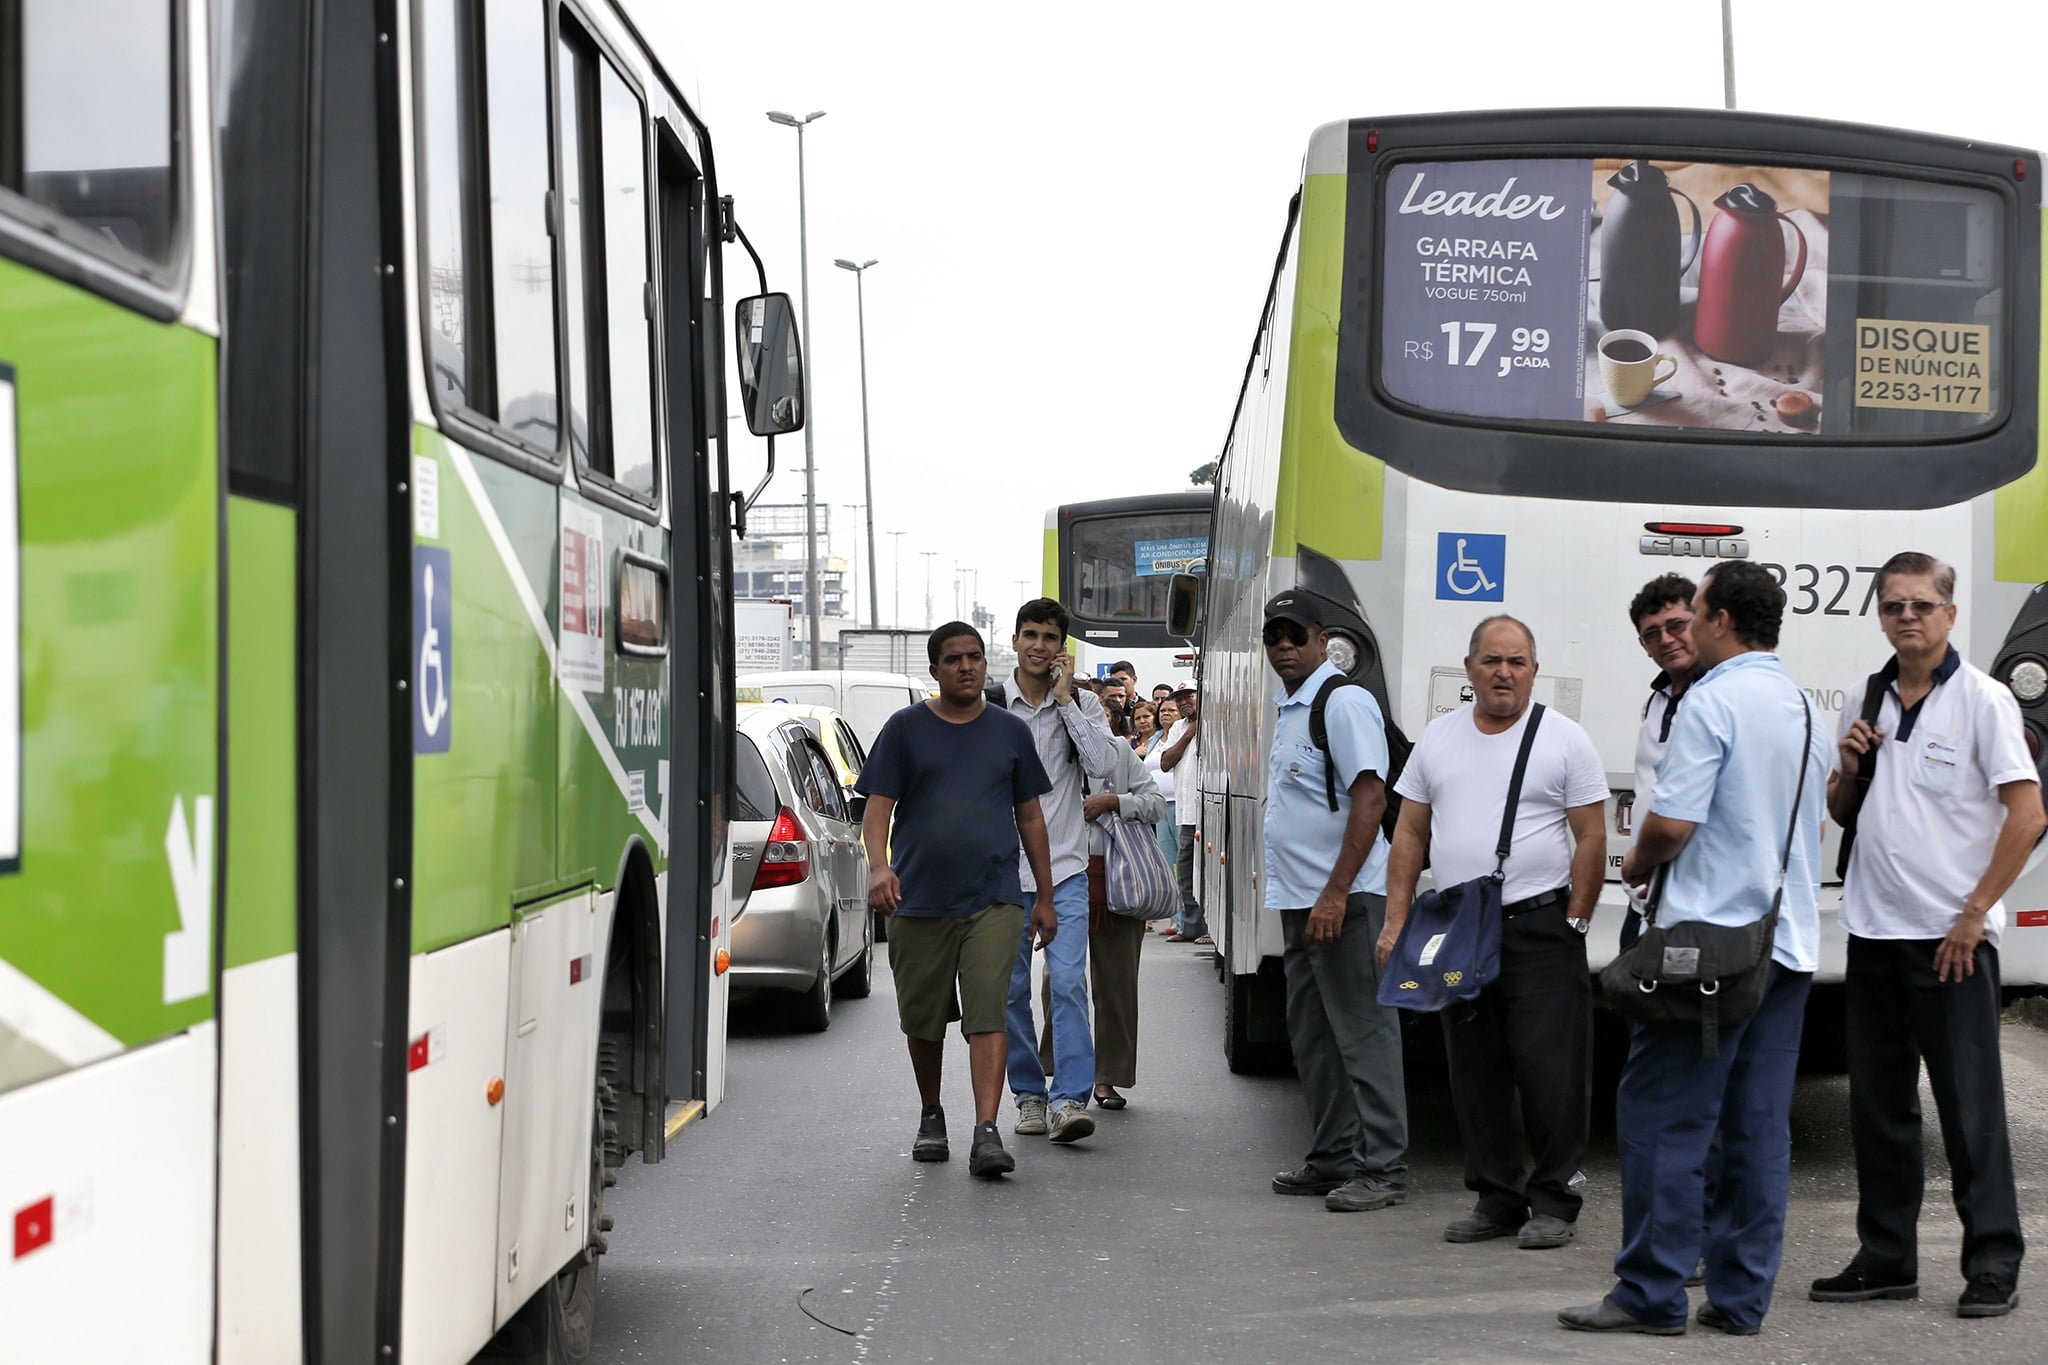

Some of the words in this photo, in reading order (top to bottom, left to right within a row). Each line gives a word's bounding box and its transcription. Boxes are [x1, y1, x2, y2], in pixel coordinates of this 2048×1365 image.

[1398, 172, 1567, 221] Leader
[1416, 236, 1539, 261] GARRAFA
[1420, 259, 1533, 287] TÉRMICA
[1425, 287, 1479, 301] VOGUE
[1483, 290, 1528, 303] 750ml
[1404, 340, 1434, 362] R$
[1861, 326, 1980, 355] DISQUE
[1513, 356, 1550, 369] CADA
[1860, 354, 1982, 379] DENÚNCIA
[1860, 380, 1982, 405] 2253-1177
[1640, 535, 1749, 558] CAIO
[736, 688, 761, 700] AXI
